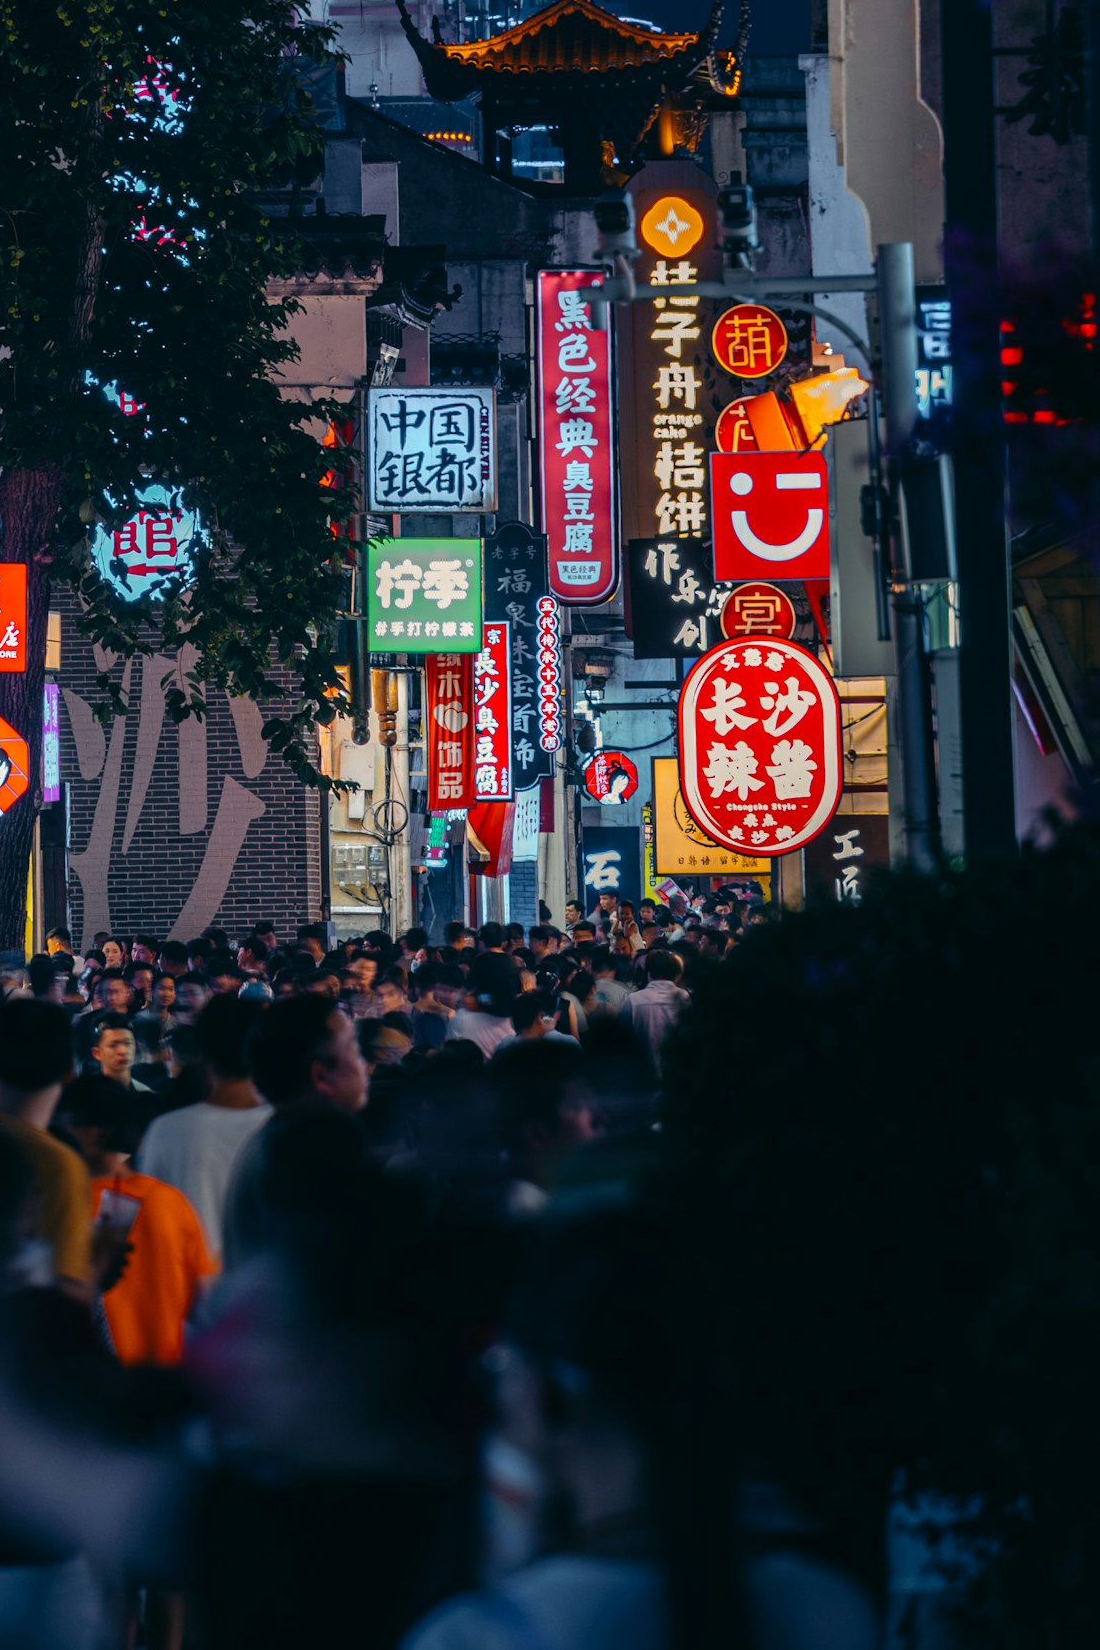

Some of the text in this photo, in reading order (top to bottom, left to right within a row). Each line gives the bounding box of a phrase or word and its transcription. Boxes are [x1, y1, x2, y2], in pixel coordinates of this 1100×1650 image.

[380, 400, 474, 452] 中国
[653, 413, 703, 427] orange
[653, 426, 688, 439] cake
[378, 447, 478, 500] 银都
[375, 559, 469, 609] 柠季
[700, 677, 817, 737] 长沙
[702, 739, 818, 801] 辣酱
[585, 851, 621, 890] 石
